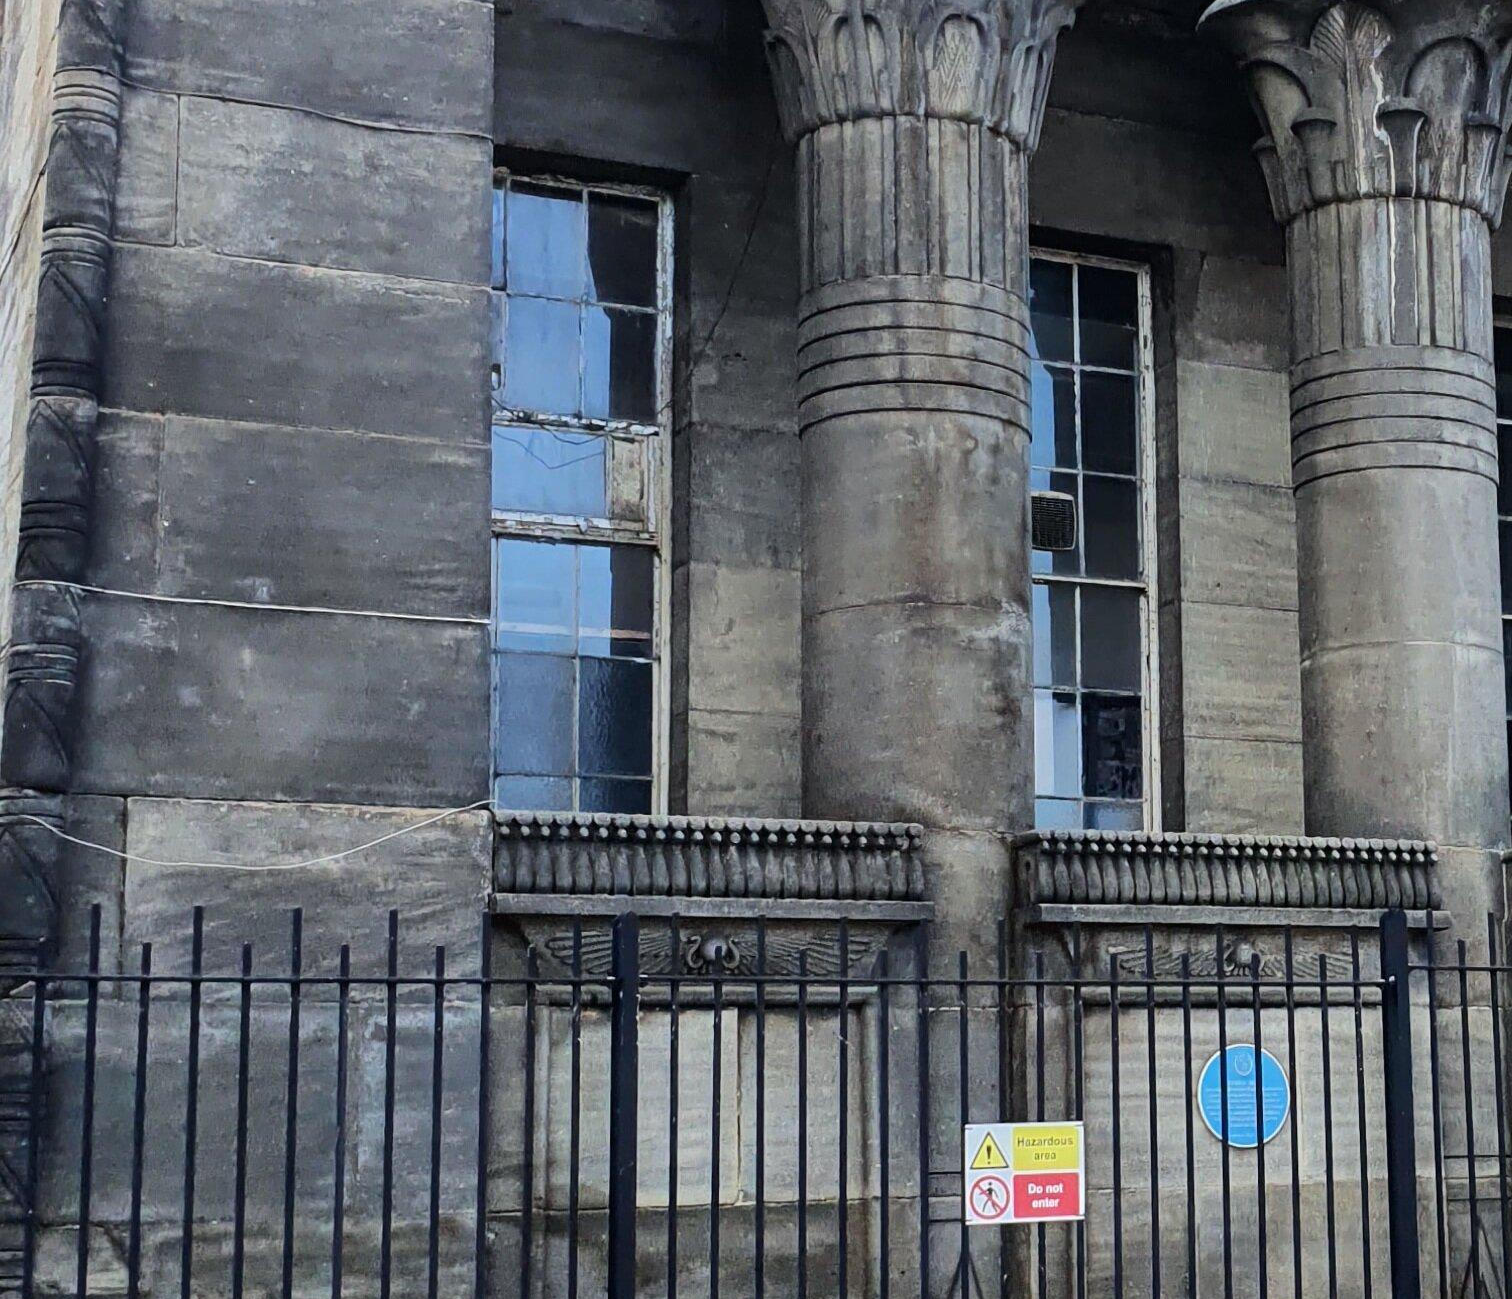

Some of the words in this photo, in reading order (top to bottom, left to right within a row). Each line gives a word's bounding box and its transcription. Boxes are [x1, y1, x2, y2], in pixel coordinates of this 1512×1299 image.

[1017, 1136, 1074, 1148] Hazardous
[1034, 1152, 1057, 1161] area
[1028, 1182, 1044, 1194] Do
[1045, 1182, 1064, 1193] not
[1031, 1197, 1061, 1209] enter
